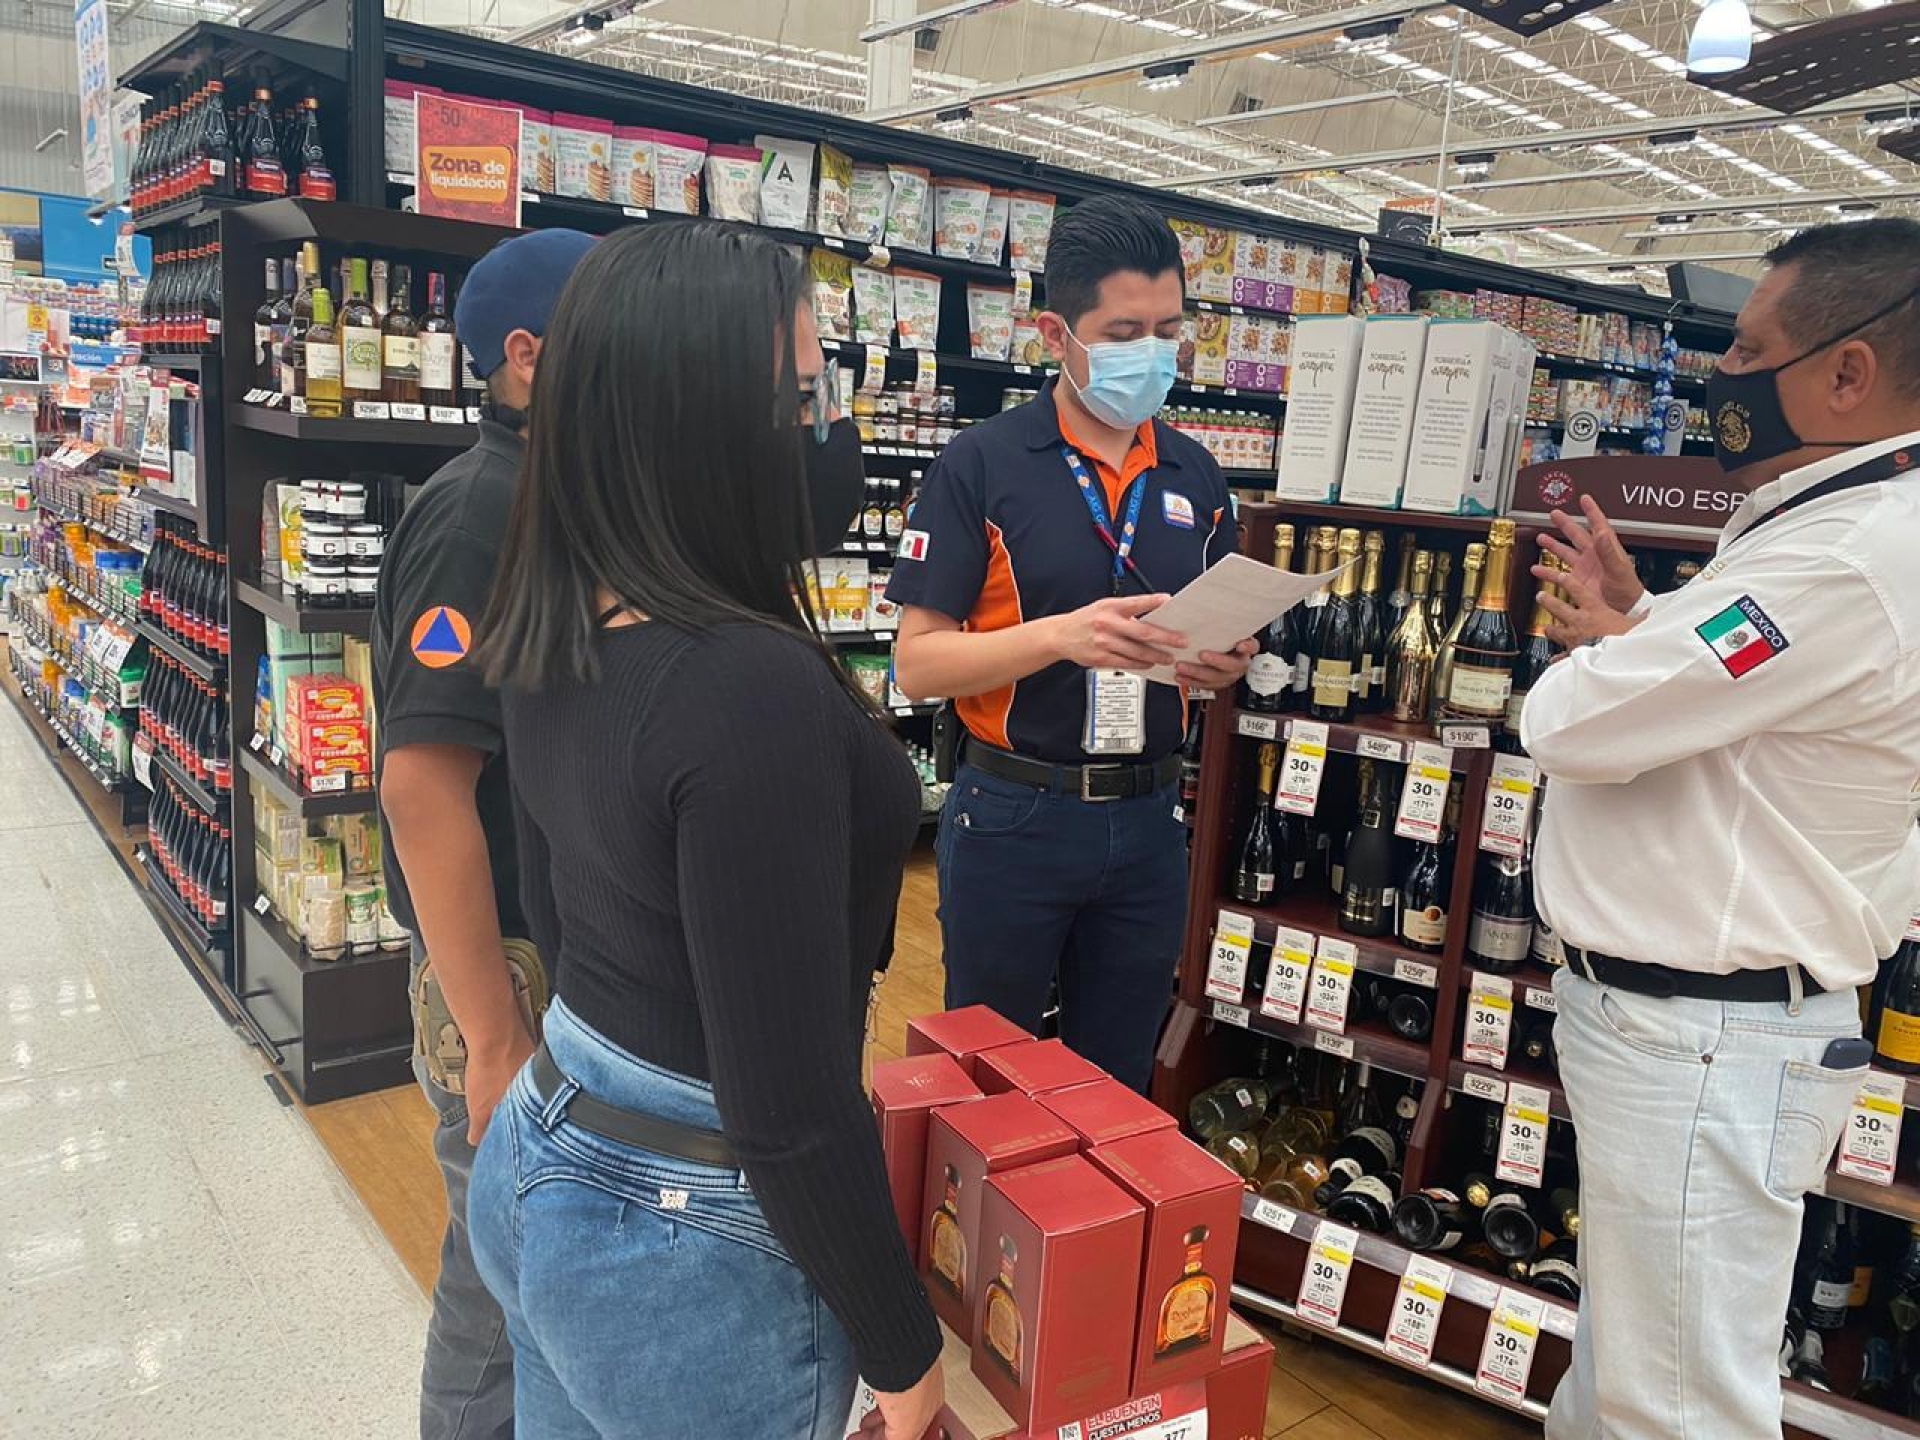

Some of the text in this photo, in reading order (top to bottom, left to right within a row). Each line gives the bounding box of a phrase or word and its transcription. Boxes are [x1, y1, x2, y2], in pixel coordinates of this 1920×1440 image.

[430, 152, 505, 175] Zona de
[777, 162, 793, 182] A
[431, 172, 507, 190] liquidación
[1622, 484, 1684, 508] VINO
[1739, 600, 1783, 648] MEXICO
[1449, 731, 1479, 742] $190
[1412, 782, 1441, 796] 30%
[1493, 795, 1524, 811] 30%
[1217, 947, 1243, 963] 30%
[1275, 964, 1302, 980] 30%
[1317, 974, 1345, 991] 30%
[1474, 1010, 1505, 1026] 30%
[1510, 1123, 1541, 1140] 30%
[1854, 1114, 1893, 1134] 30%
[1261, 1205, 1287, 1221] $251
[1313, 1262, 1342, 1282] 30%
[1403, 1297, 1434, 1318] 30%
[1494, 1332, 1527, 1354] 30%
[1086, 1393, 1162, 1431] EL BUEN FIN
[1089, 1422, 1126, 1440] CUESTA
[1126, 1410, 1161, 1431] MENOS
